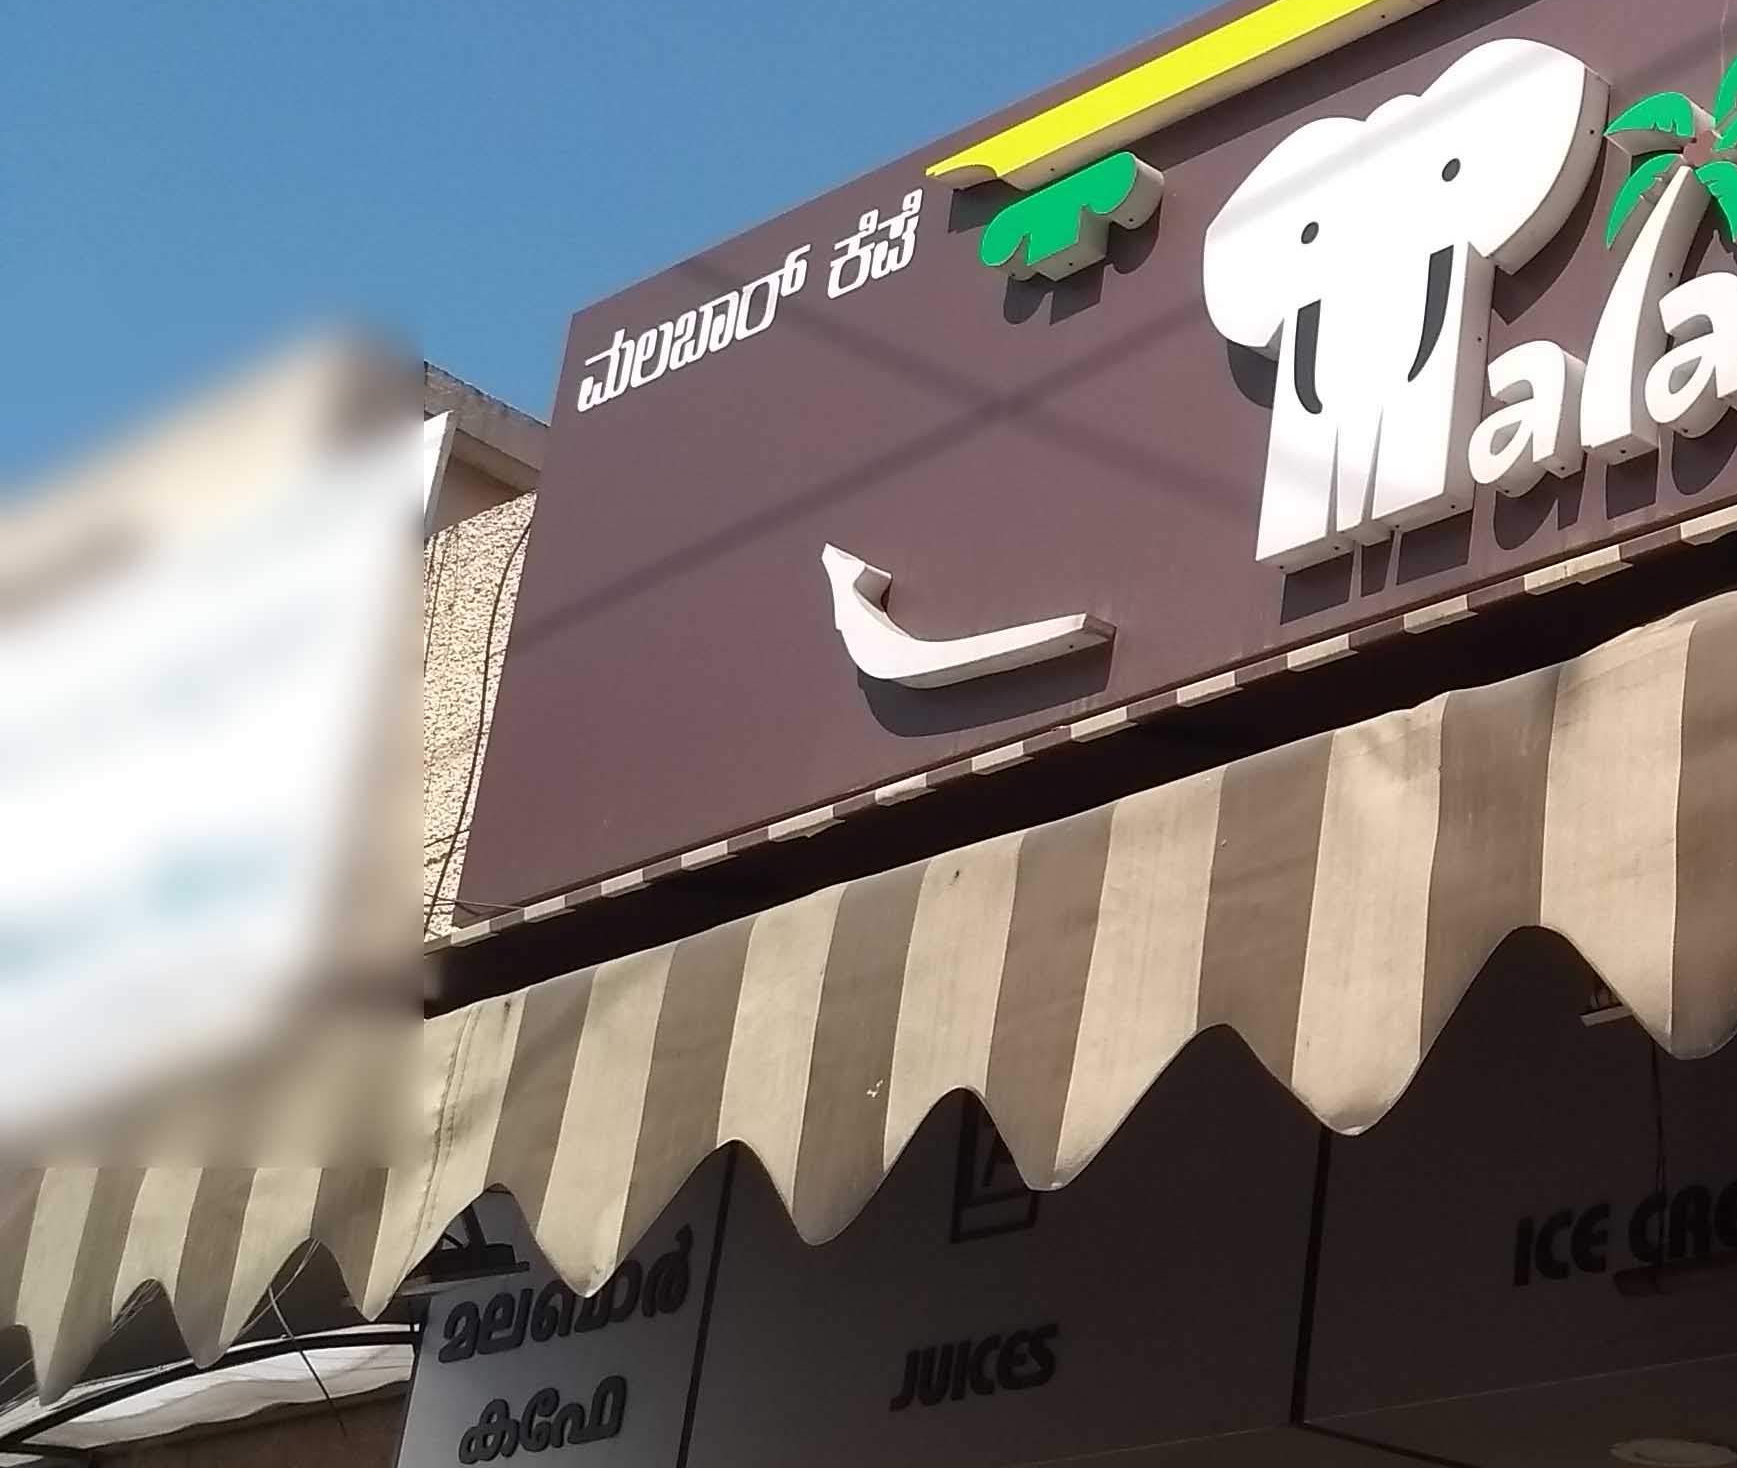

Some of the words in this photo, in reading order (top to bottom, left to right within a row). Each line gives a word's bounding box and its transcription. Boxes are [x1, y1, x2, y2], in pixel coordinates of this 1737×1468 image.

[576, 243, 812, 413] ಮಲಬಾರ್
[1512, 1201, 1611, 1289] ICE
[888, 1319, 1062, 1413] JUICES
